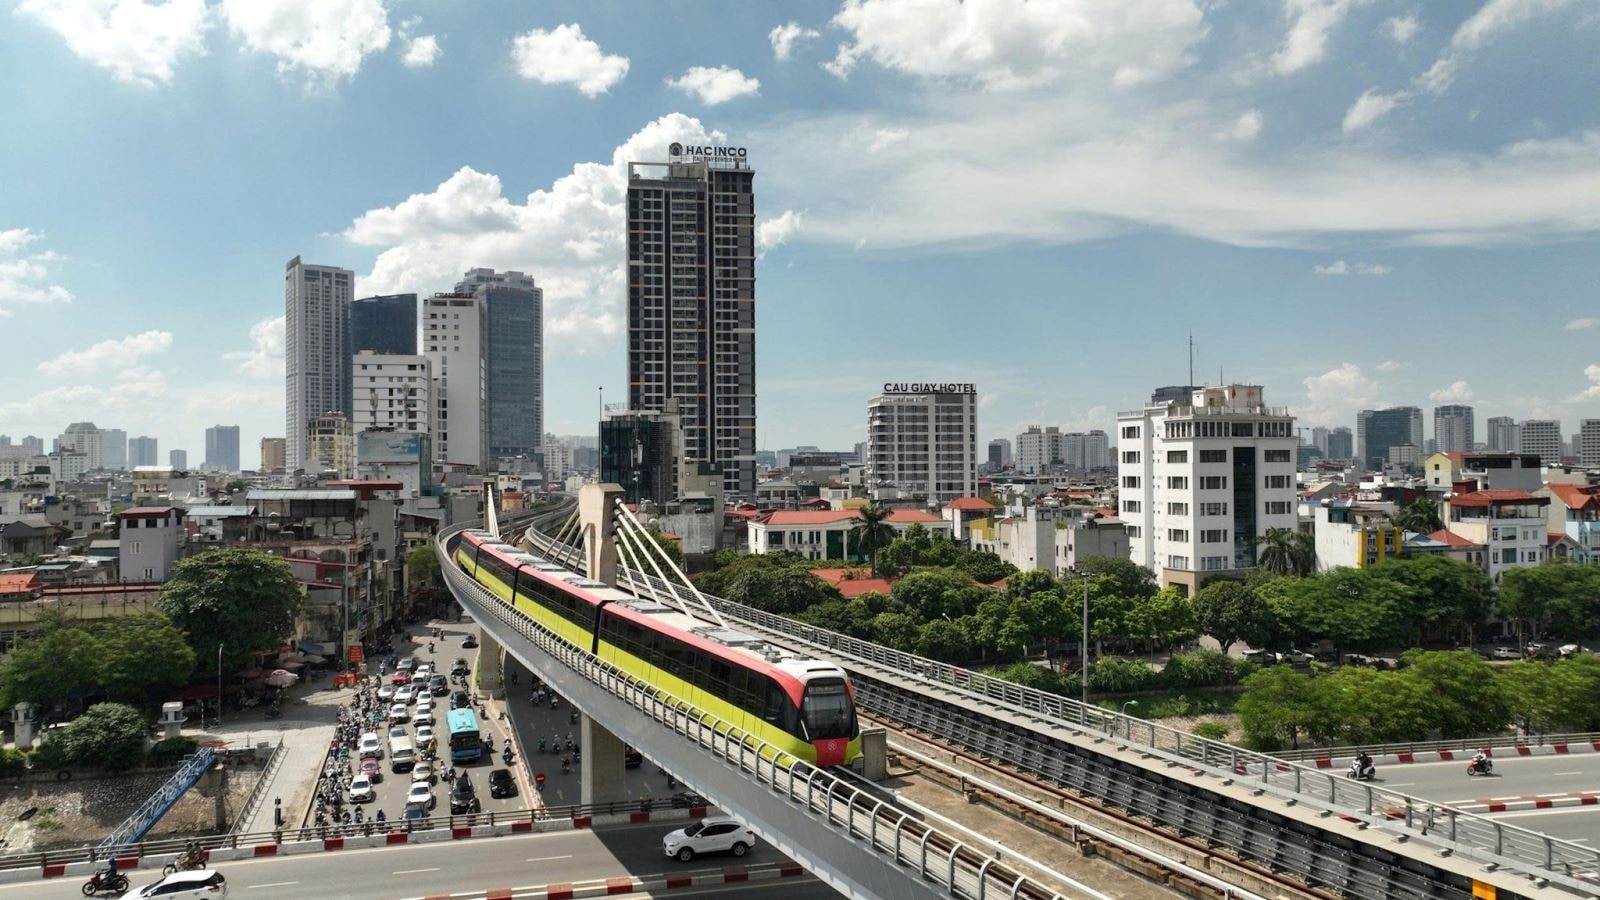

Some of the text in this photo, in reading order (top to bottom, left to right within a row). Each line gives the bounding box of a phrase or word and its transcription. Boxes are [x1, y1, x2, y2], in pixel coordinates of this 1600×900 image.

[686, 145, 747, 157] HACINCO
[884, 383, 977, 393] CAU GIAY HOTEL
